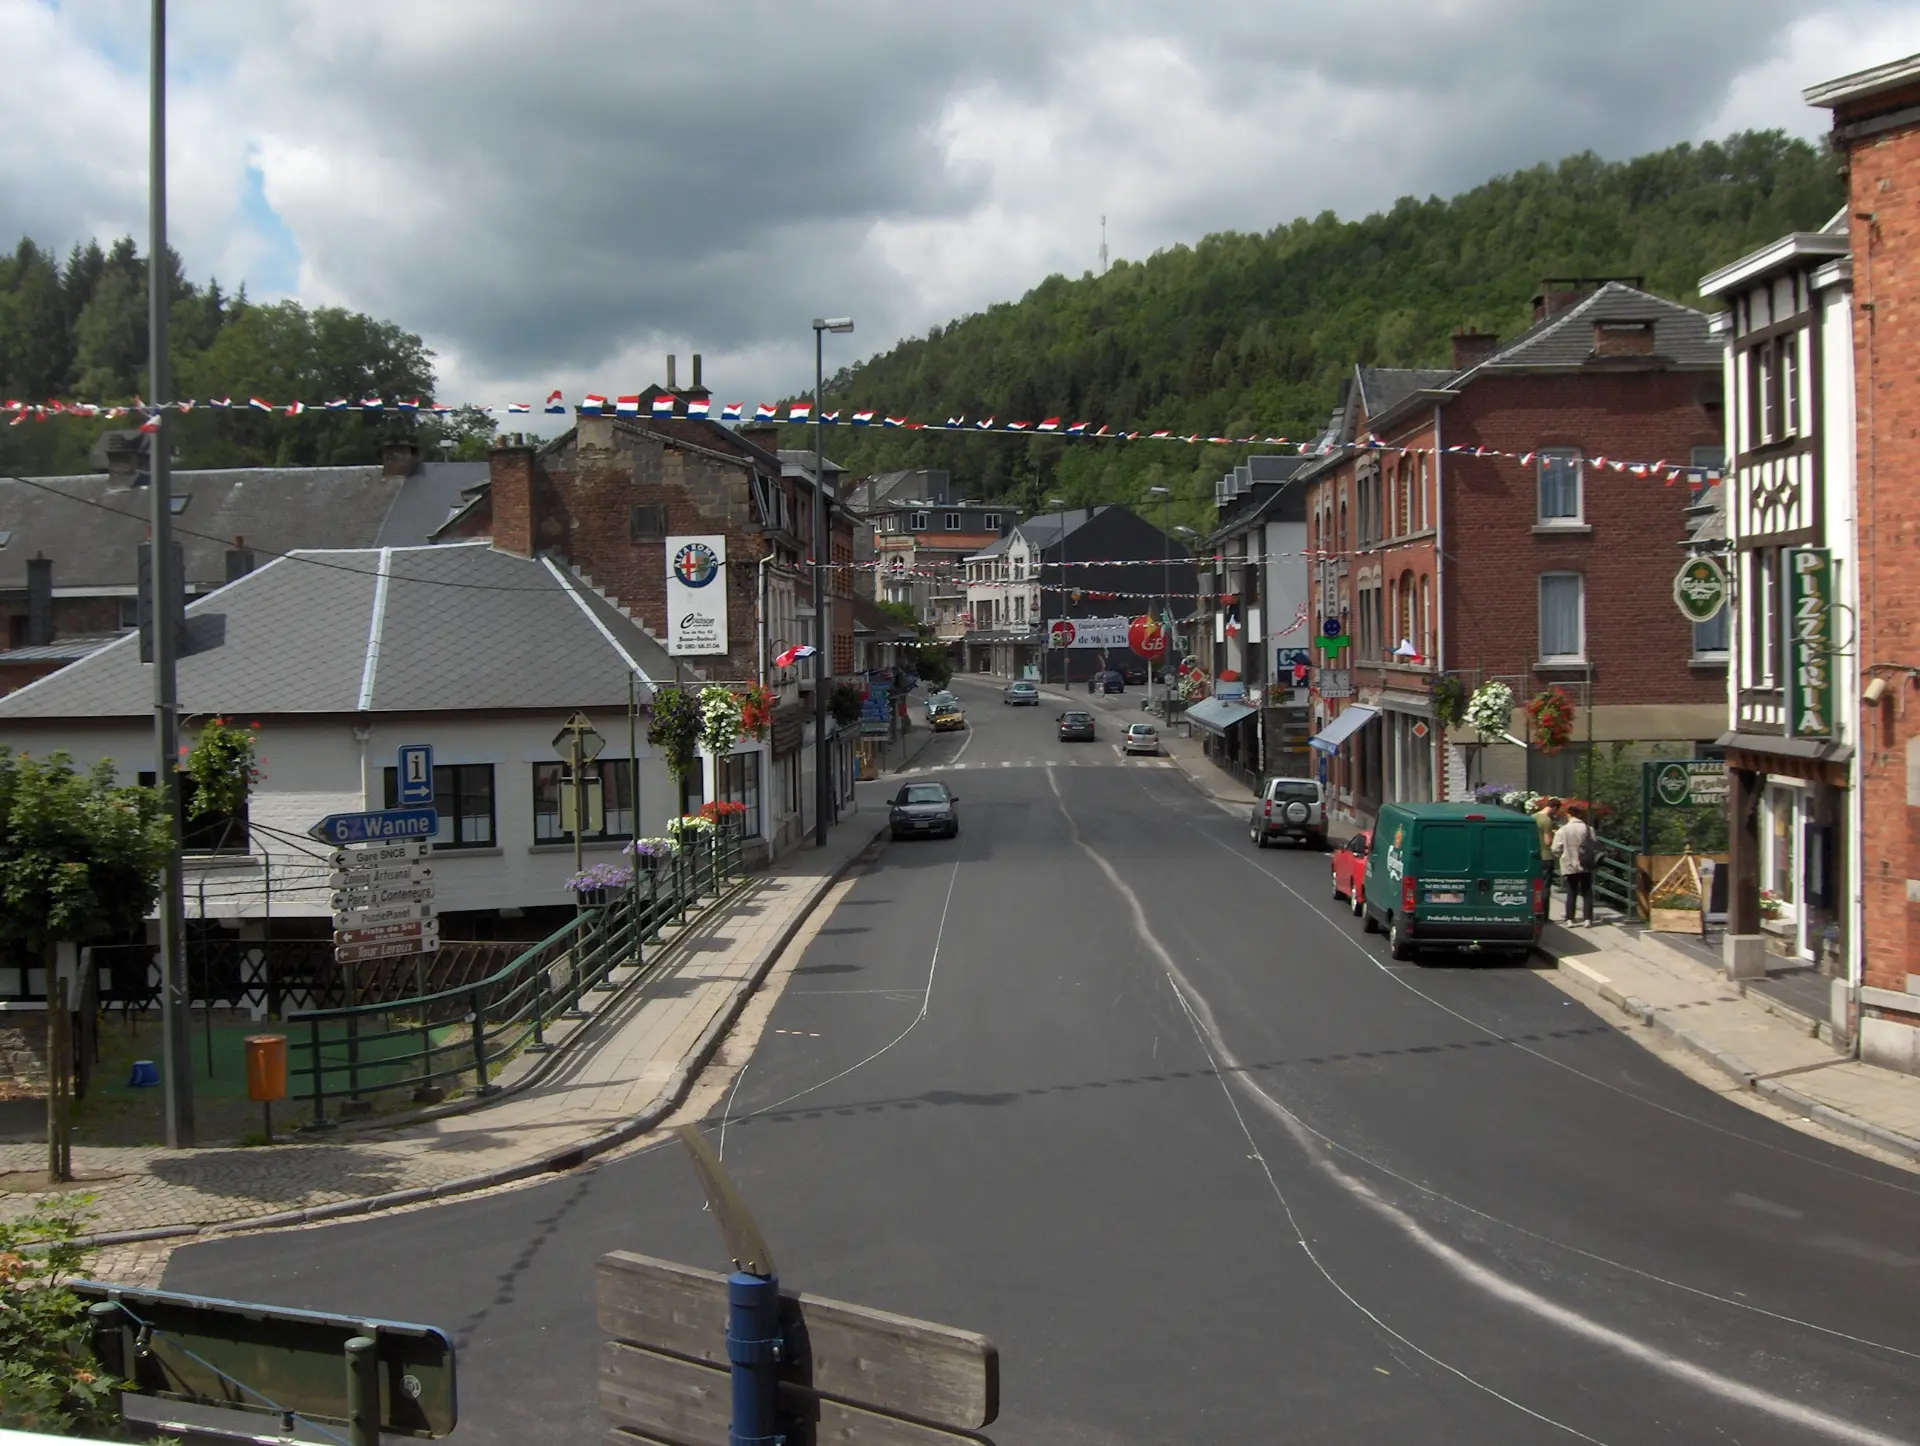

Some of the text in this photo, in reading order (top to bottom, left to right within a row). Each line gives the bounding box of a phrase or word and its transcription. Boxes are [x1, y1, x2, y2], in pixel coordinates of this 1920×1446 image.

[1078, 635, 1089, 644] de
[1091, 635, 1101, 644] 9h
[1112, 635, 1127, 644] 12h
[1141, 637, 1165, 651] GB
[1795, 552, 1828, 733] PIZZERIA
[1687, 762, 1726, 773] PIZZE
[363, 817, 429, 837] Wanne
[356, 848, 405, 862] Gare SNCB
[343, 868, 411, 886] Zoning Artisanal
[347, 887, 431, 905] Parc à Conteneurs
[1492, 891, 1528, 906] Carlsberg
[360, 928, 384, 936] Piste
[401, 923, 416, 931] Ski
[358, 943, 413, 958] Tour Leroux
